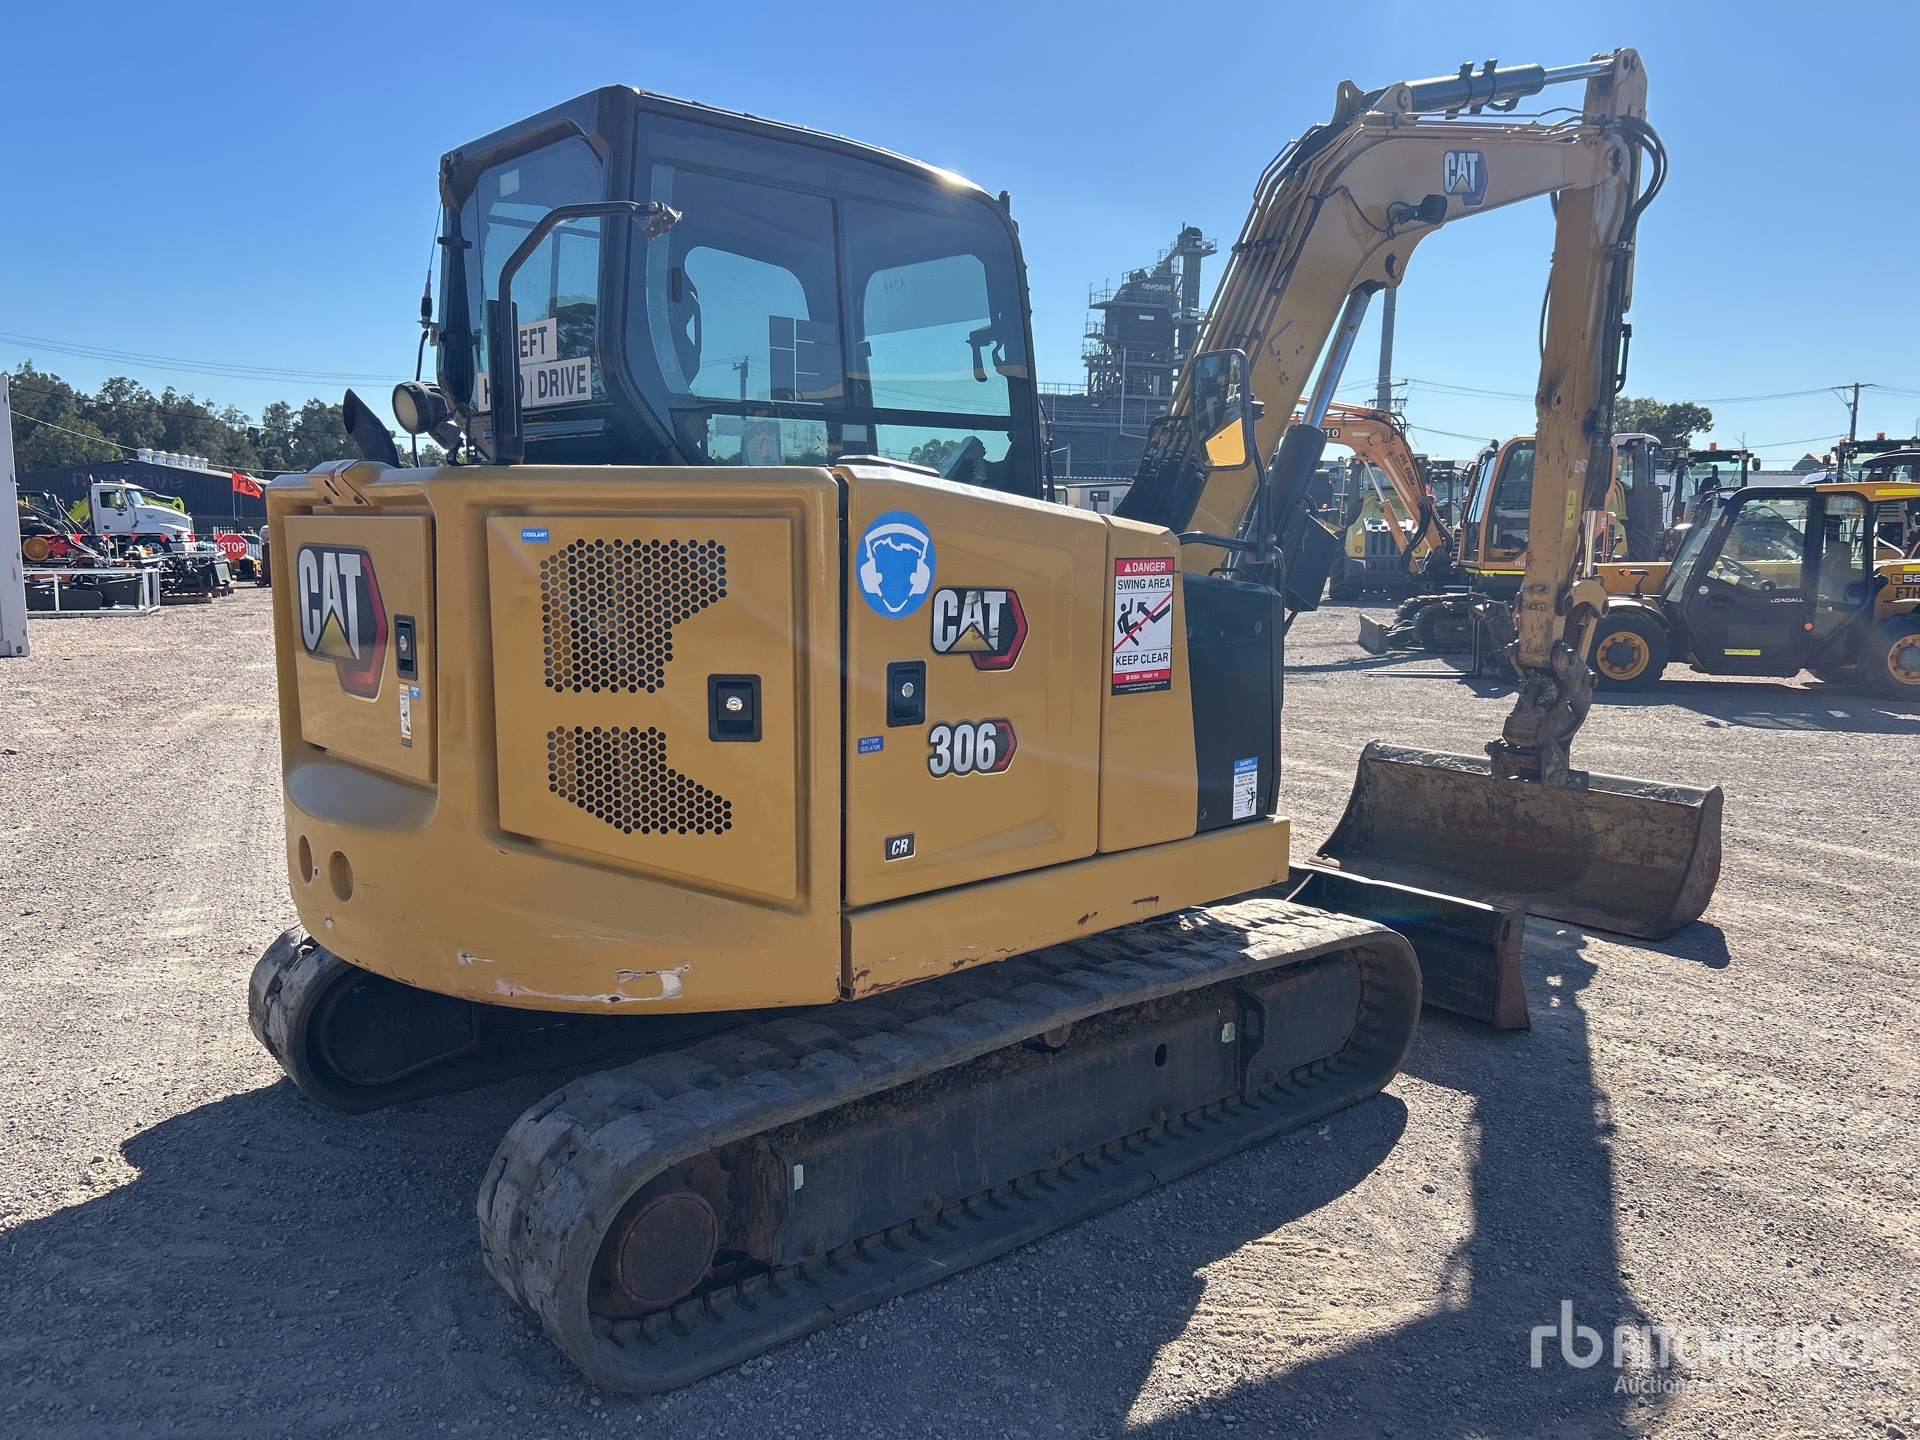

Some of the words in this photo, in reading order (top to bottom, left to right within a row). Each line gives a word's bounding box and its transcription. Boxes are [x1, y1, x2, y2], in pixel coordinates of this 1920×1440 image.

[1444, 151, 1479, 193] CAT
[1141, 282, 1172, 292] newpave
[519, 326, 547, 358] EFT
[537, 364, 587, 399] DRIVE
[72, 472, 184, 490] nwave
[219, 541, 246, 553] STOP
[1132, 561, 1167, 573] DANGER
[1117, 578, 1146, 591] SWING
[1147, 578, 1171, 589] AREA
[298, 548, 362, 660] CAT
[933, 588, 1008, 652] CAT
[1115, 654, 1139, 667] KEEP
[1140, 652, 1169, 664] CLEAR
[929, 722, 997, 775] 306
[891, 838, 909, 856] CR
